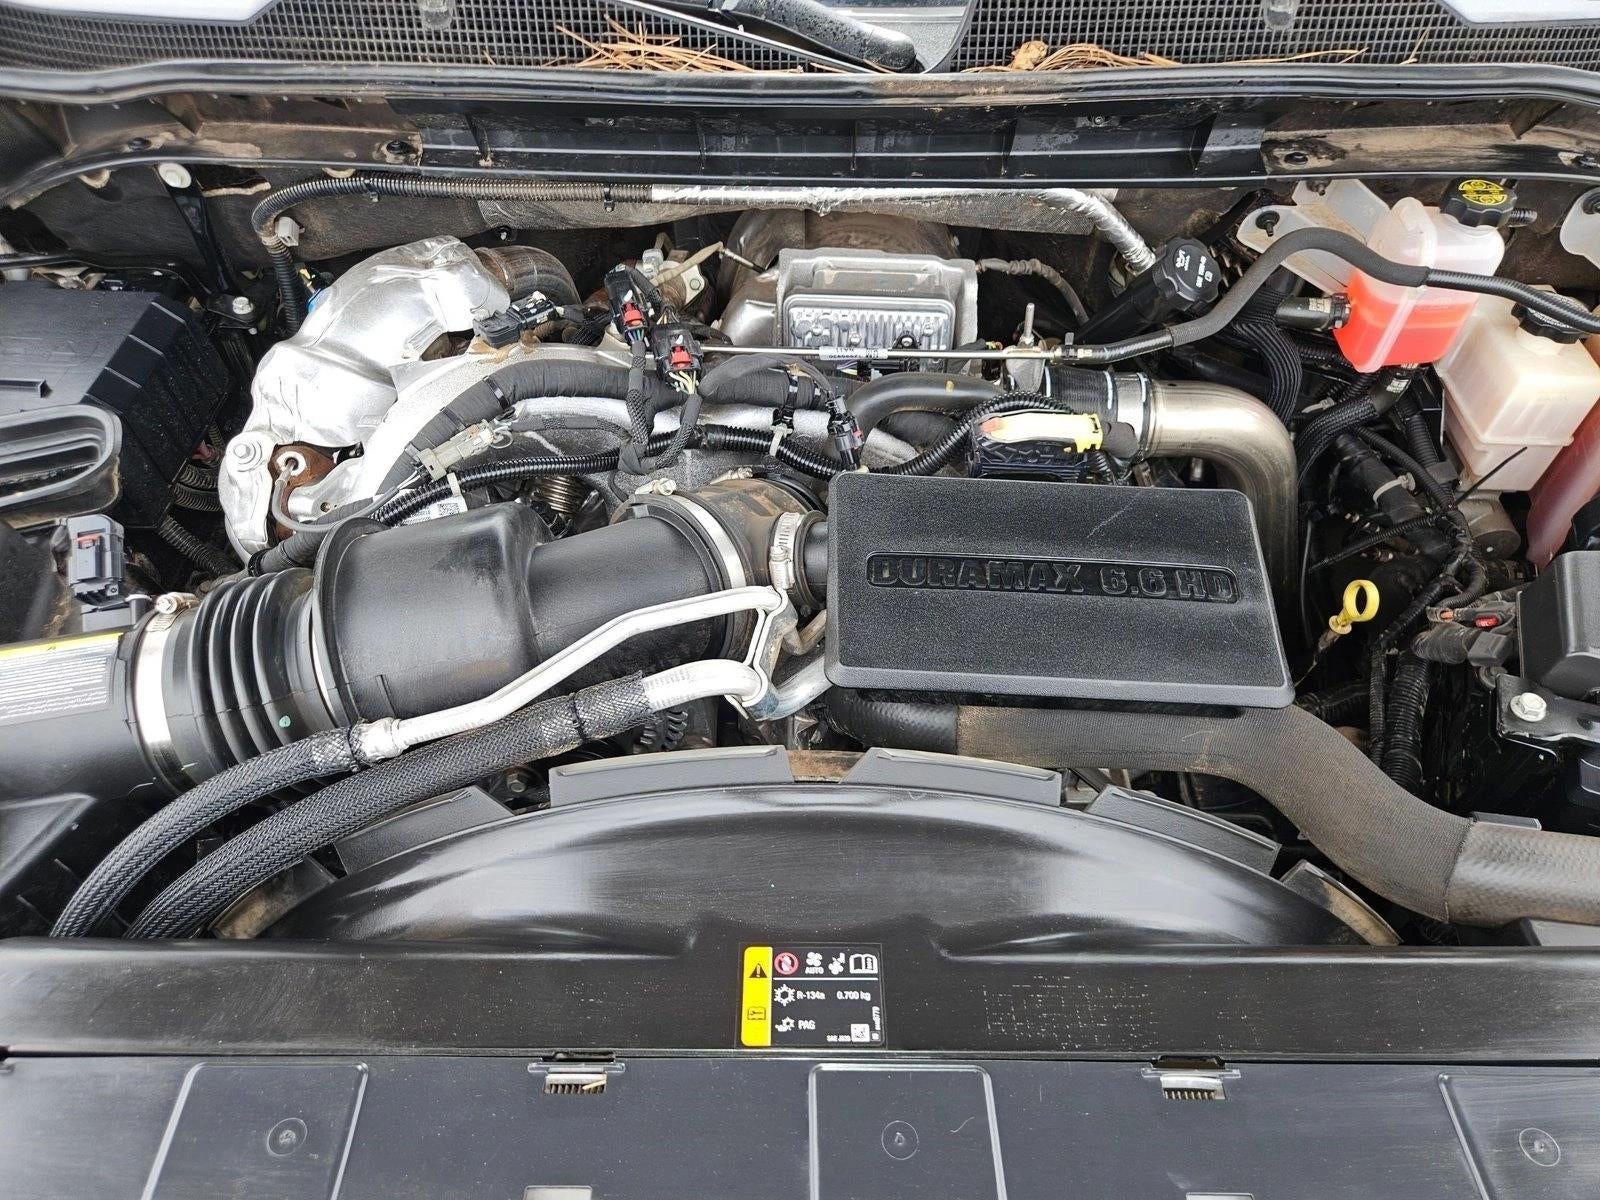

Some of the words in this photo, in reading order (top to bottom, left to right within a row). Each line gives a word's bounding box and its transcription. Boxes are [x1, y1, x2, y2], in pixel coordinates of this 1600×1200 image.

[872, 556, 1084, 593] DURAMAX
[1099, 566, 1167, 597] 6.6
[1174, 569, 1235, 602] HD
[804, 966, 824, 975] AUTO
[796, 990, 826, 1000] R-134a
[836, 990, 859, 1000] 0.700
[860, 990, 871, 1002] kg
[798, 1019, 816, 1030] PAG
